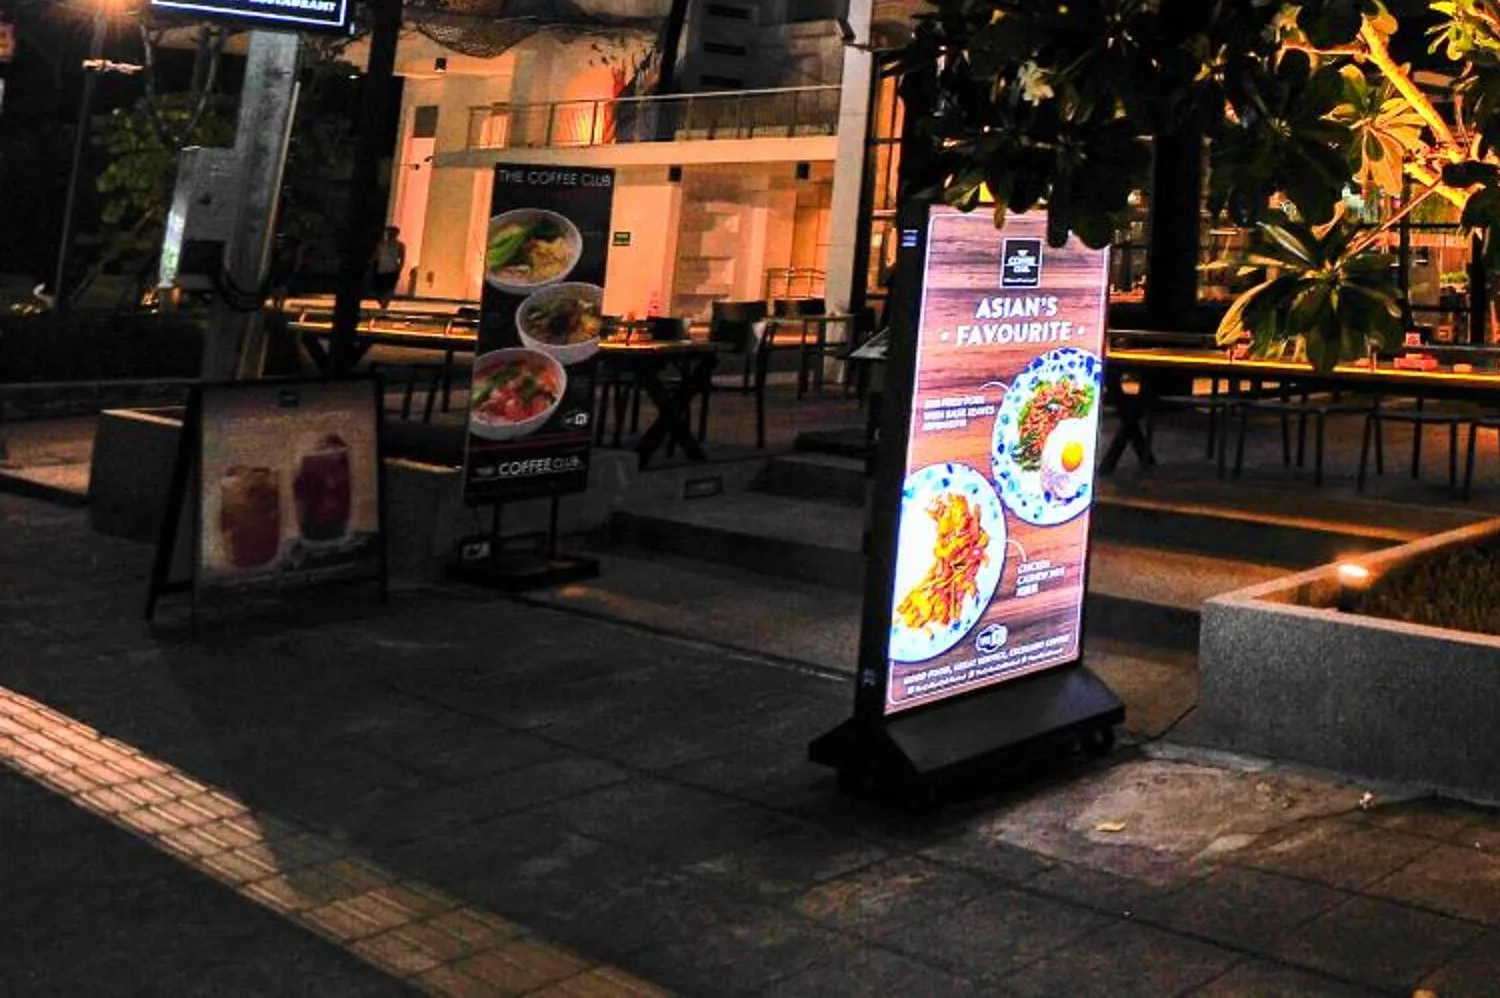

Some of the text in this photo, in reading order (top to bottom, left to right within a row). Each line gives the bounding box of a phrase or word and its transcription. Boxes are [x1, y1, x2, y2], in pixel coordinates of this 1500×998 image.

[527, 170, 578, 187] COFFEE
[580, 172, 612, 188] CLUB
[975, 296, 1059, 319] ASIAN'S
[956, 321, 1073, 346] FAVOURITE
[499, 458, 552, 476] COFFEE
